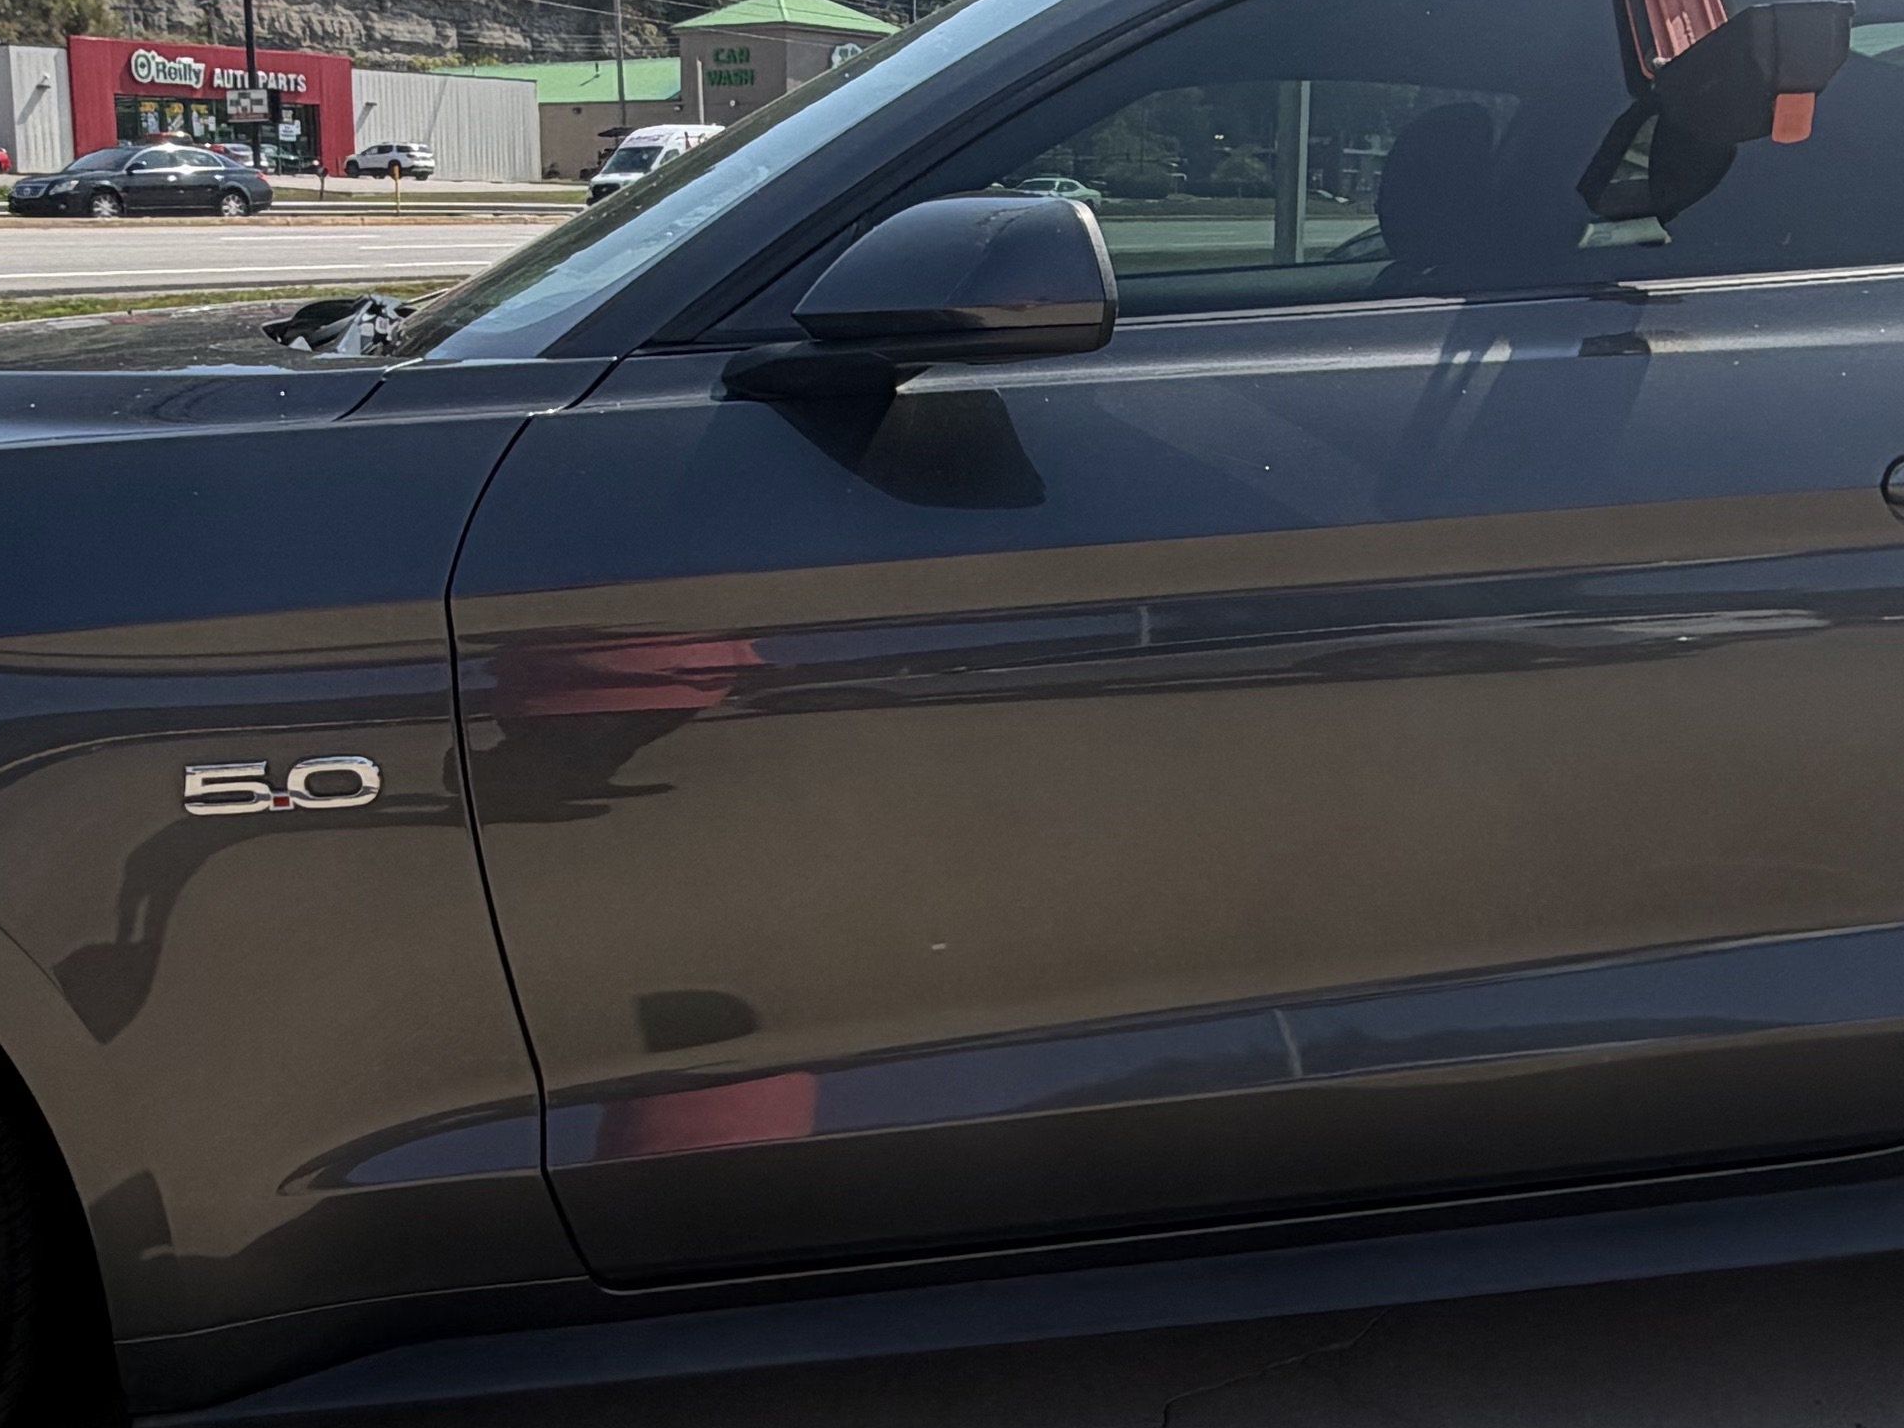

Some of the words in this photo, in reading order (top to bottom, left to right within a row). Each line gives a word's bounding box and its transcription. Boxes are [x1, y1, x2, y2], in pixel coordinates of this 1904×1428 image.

[131, 48, 206, 89] O'Reilly
[256, 71, 307, 93] PARTS
[707, 68, 754, 87] WASH
[183, 755, 382, 817] 5.0
